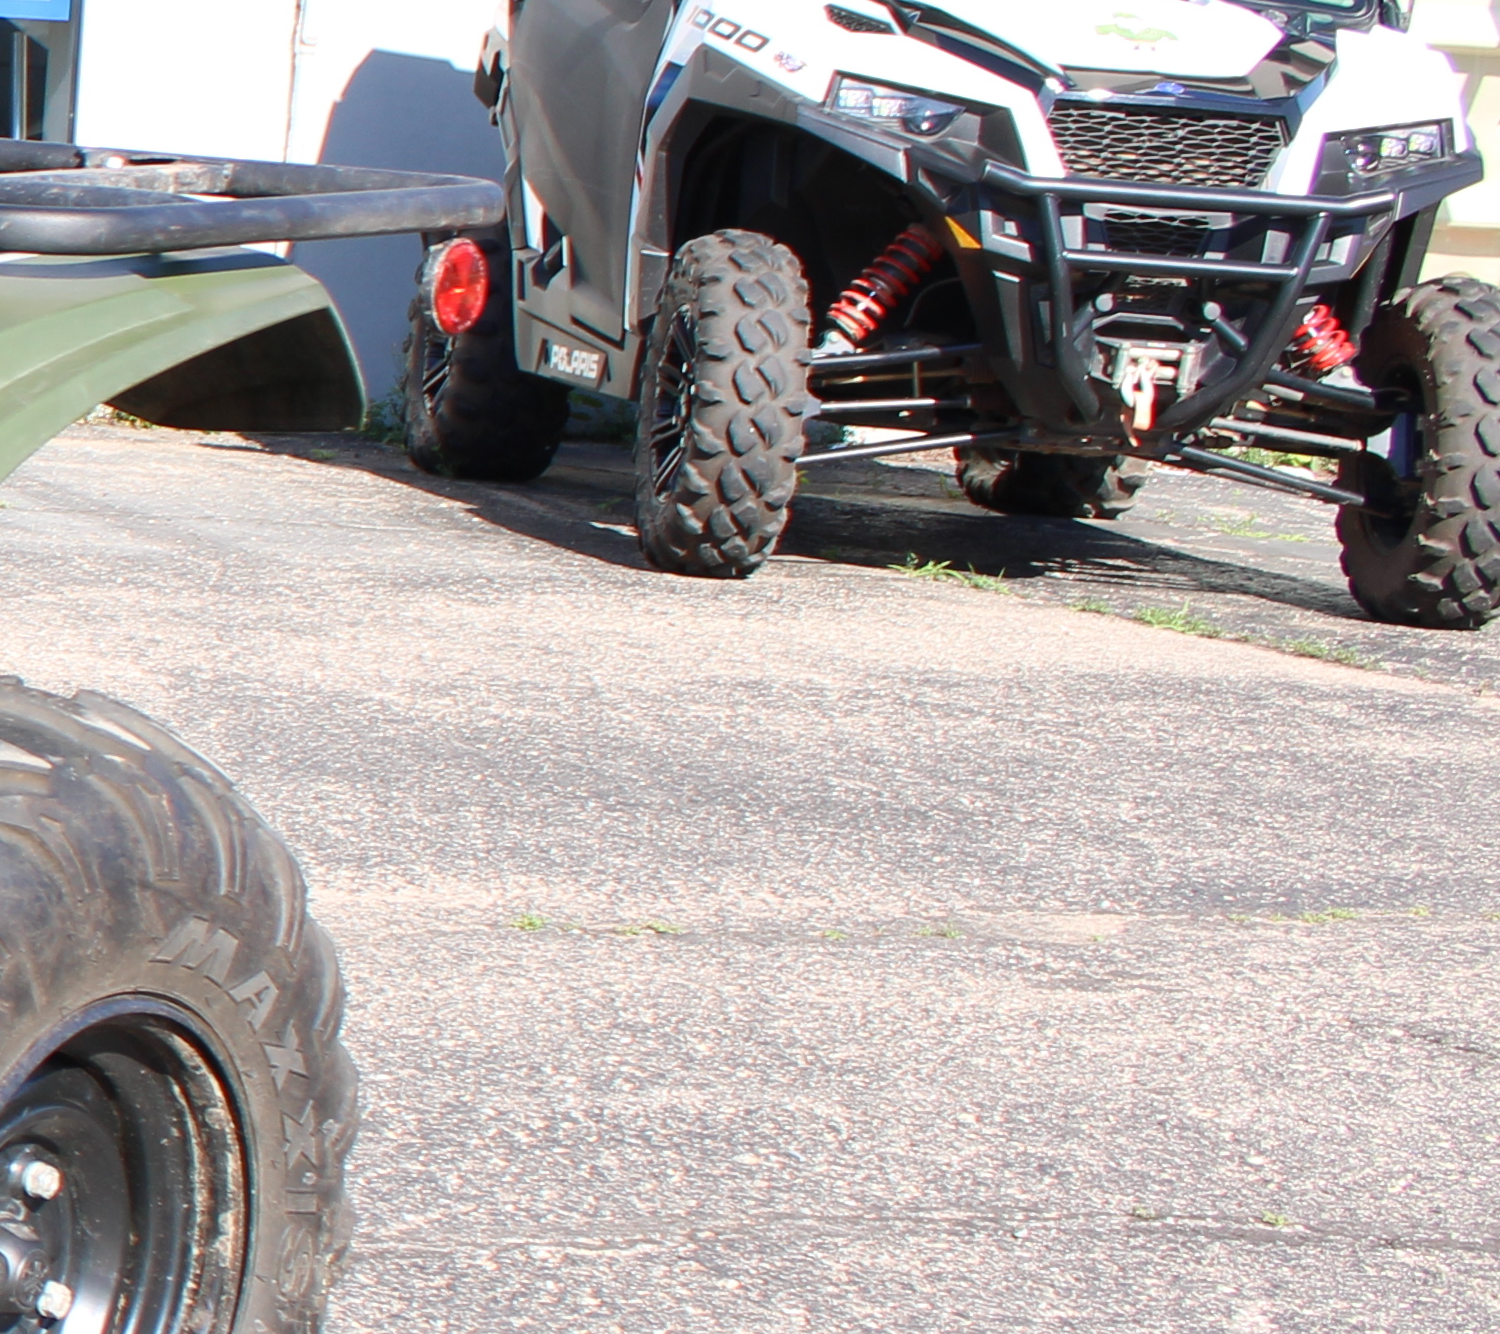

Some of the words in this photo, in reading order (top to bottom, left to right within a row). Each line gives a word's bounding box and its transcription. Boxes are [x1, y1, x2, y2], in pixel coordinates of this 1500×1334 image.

[687, 5, 770, 53] 1000
[550, 344, 600, 379] POLARIS
[148, 915, 318, 1295] MAXXIS
